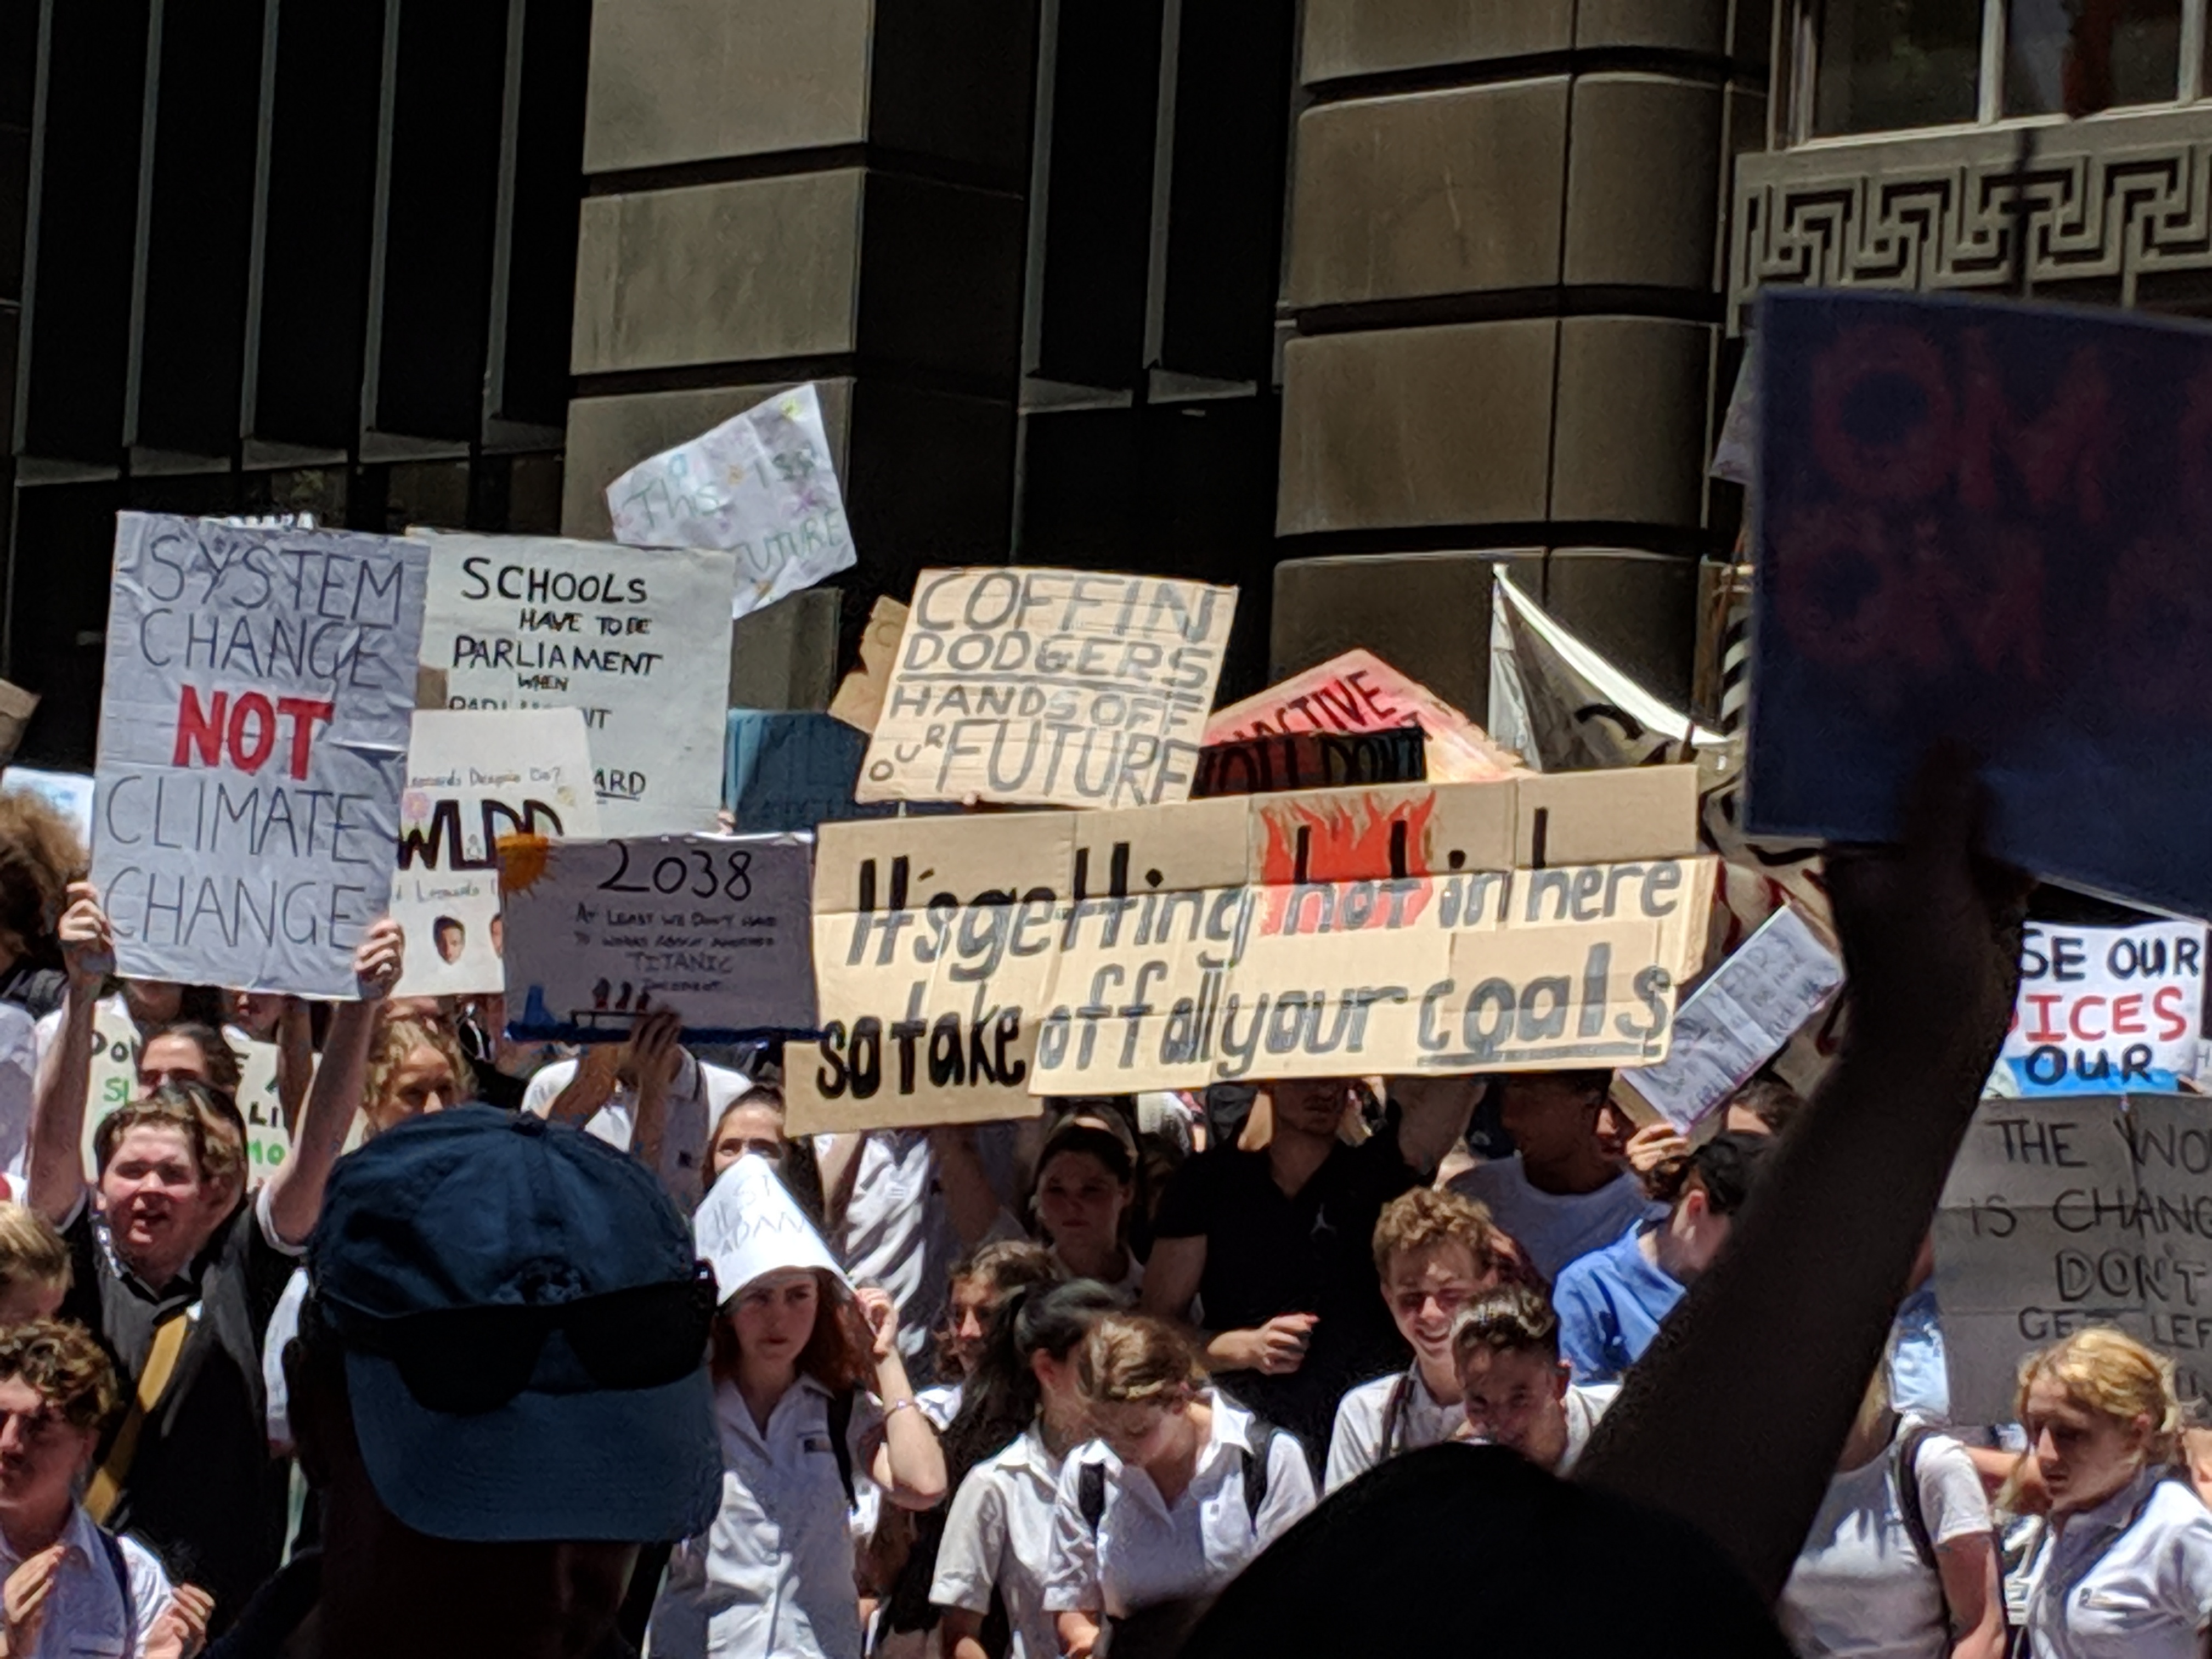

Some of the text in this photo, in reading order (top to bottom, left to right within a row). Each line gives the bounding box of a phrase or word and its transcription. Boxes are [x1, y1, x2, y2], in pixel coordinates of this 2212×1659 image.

[147, 534, 403, 624] SYSTEM
[460, 556, 648, 604] SCHOOLS
[916, 571, 1216, 644] COFFIN
[139, 607, 393, 690] CHANGE
[518, 608, 583, 633] HAVE
[595, 616, 623, 635] TO
[453, 635, 664, 676] PARLIAMENT
[902, 630, 1215, 689] DODGERS
[172, 683, 335, 781] NOT
[889, 684, 1204, 736] HANDS OFF
[868, 724, 945, 782] OUR
[936, 718, 1202, 808] FUTURE
[106, 775, 374, 865] CLIMATE
[597, 838, 752, 901] 2038
[1283, 820, 1423, 936] hot
[1438, 849, 1511, 929] in
[1525, 806, 1683, 923] here
[103, 866, 365, 950] CHANGE
[2106, 936, 2200, 979] OUR
[889, 979, 1027, 1096] take
[1038, 960, 1168, 1071] off
[1417, 941, 1672, 1059] coals
[2007, 986, 2188, 1042] ICES
[2024, 1043, 2154, 1086] OUR
[1983, 1116, 2212, 1175] THE WO
